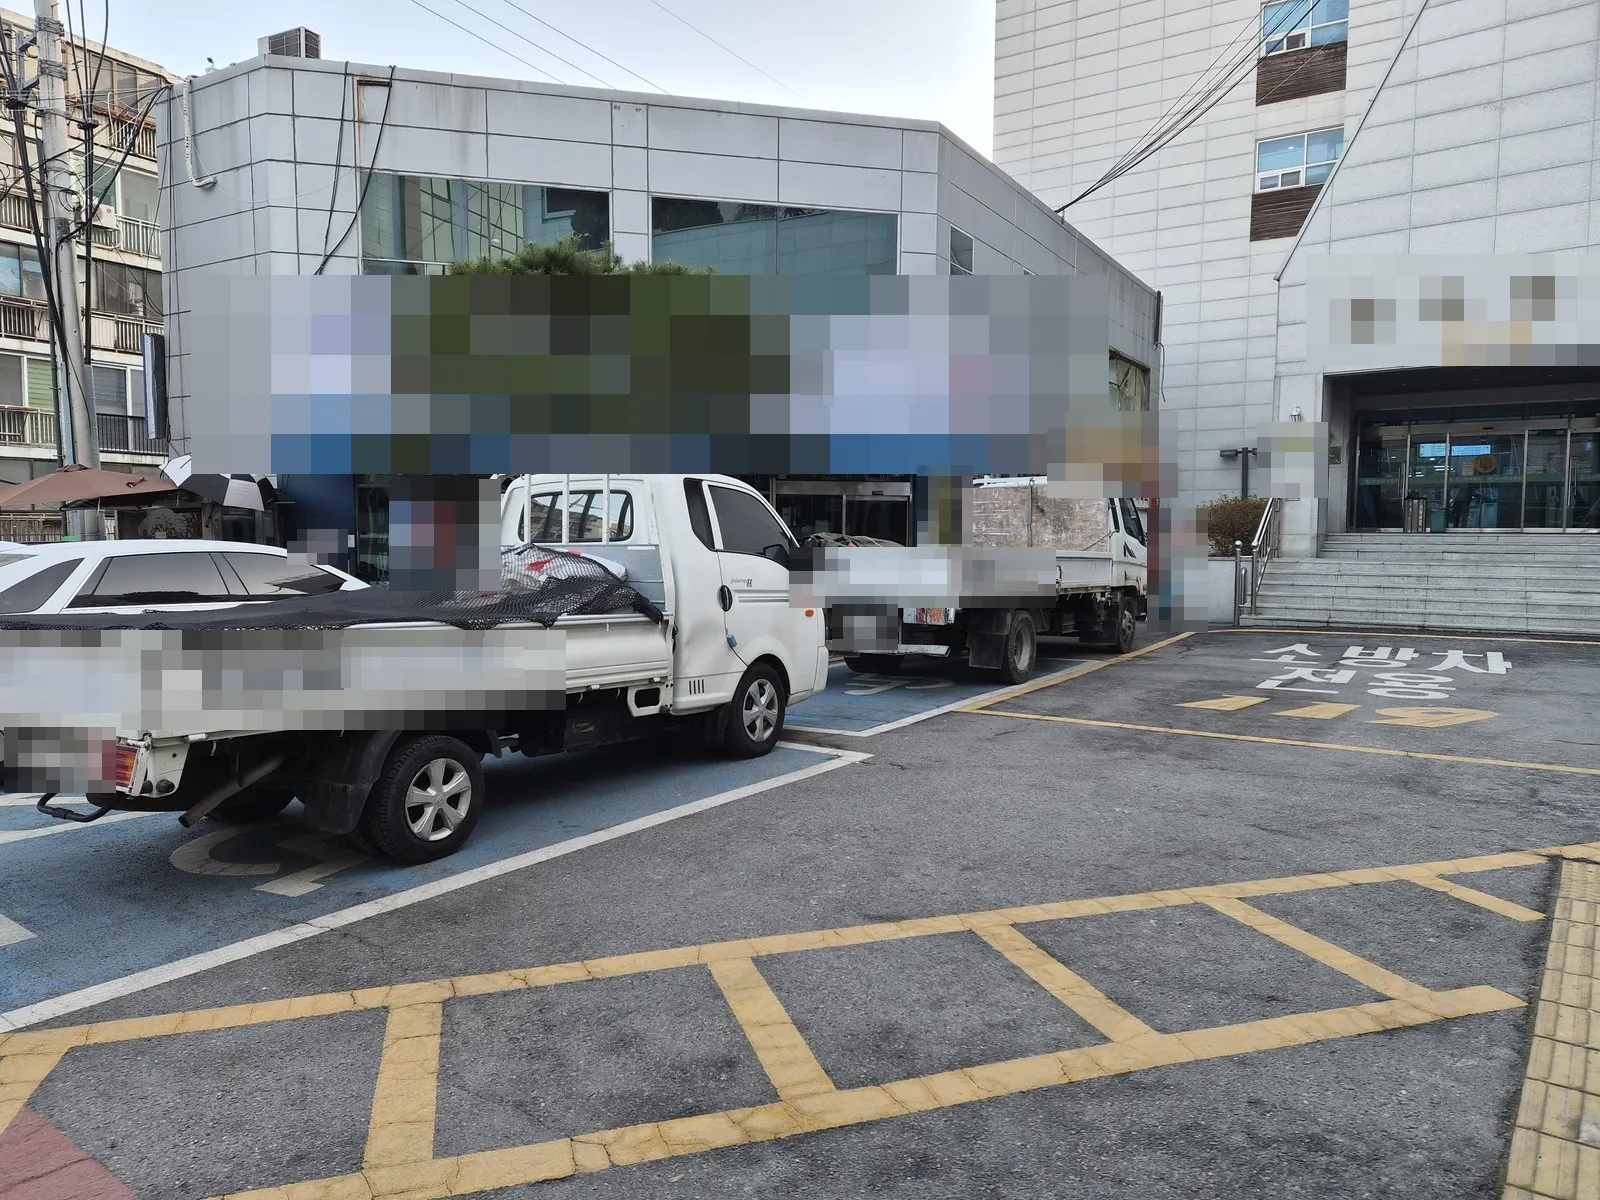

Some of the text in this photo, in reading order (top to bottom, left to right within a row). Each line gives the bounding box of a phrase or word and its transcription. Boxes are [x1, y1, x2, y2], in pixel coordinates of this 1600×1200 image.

[1250, 643, 1512, 674] 소방차
[1256, 667, 1456, 699] 전용
[1172, 694, 1499, 728] 119
